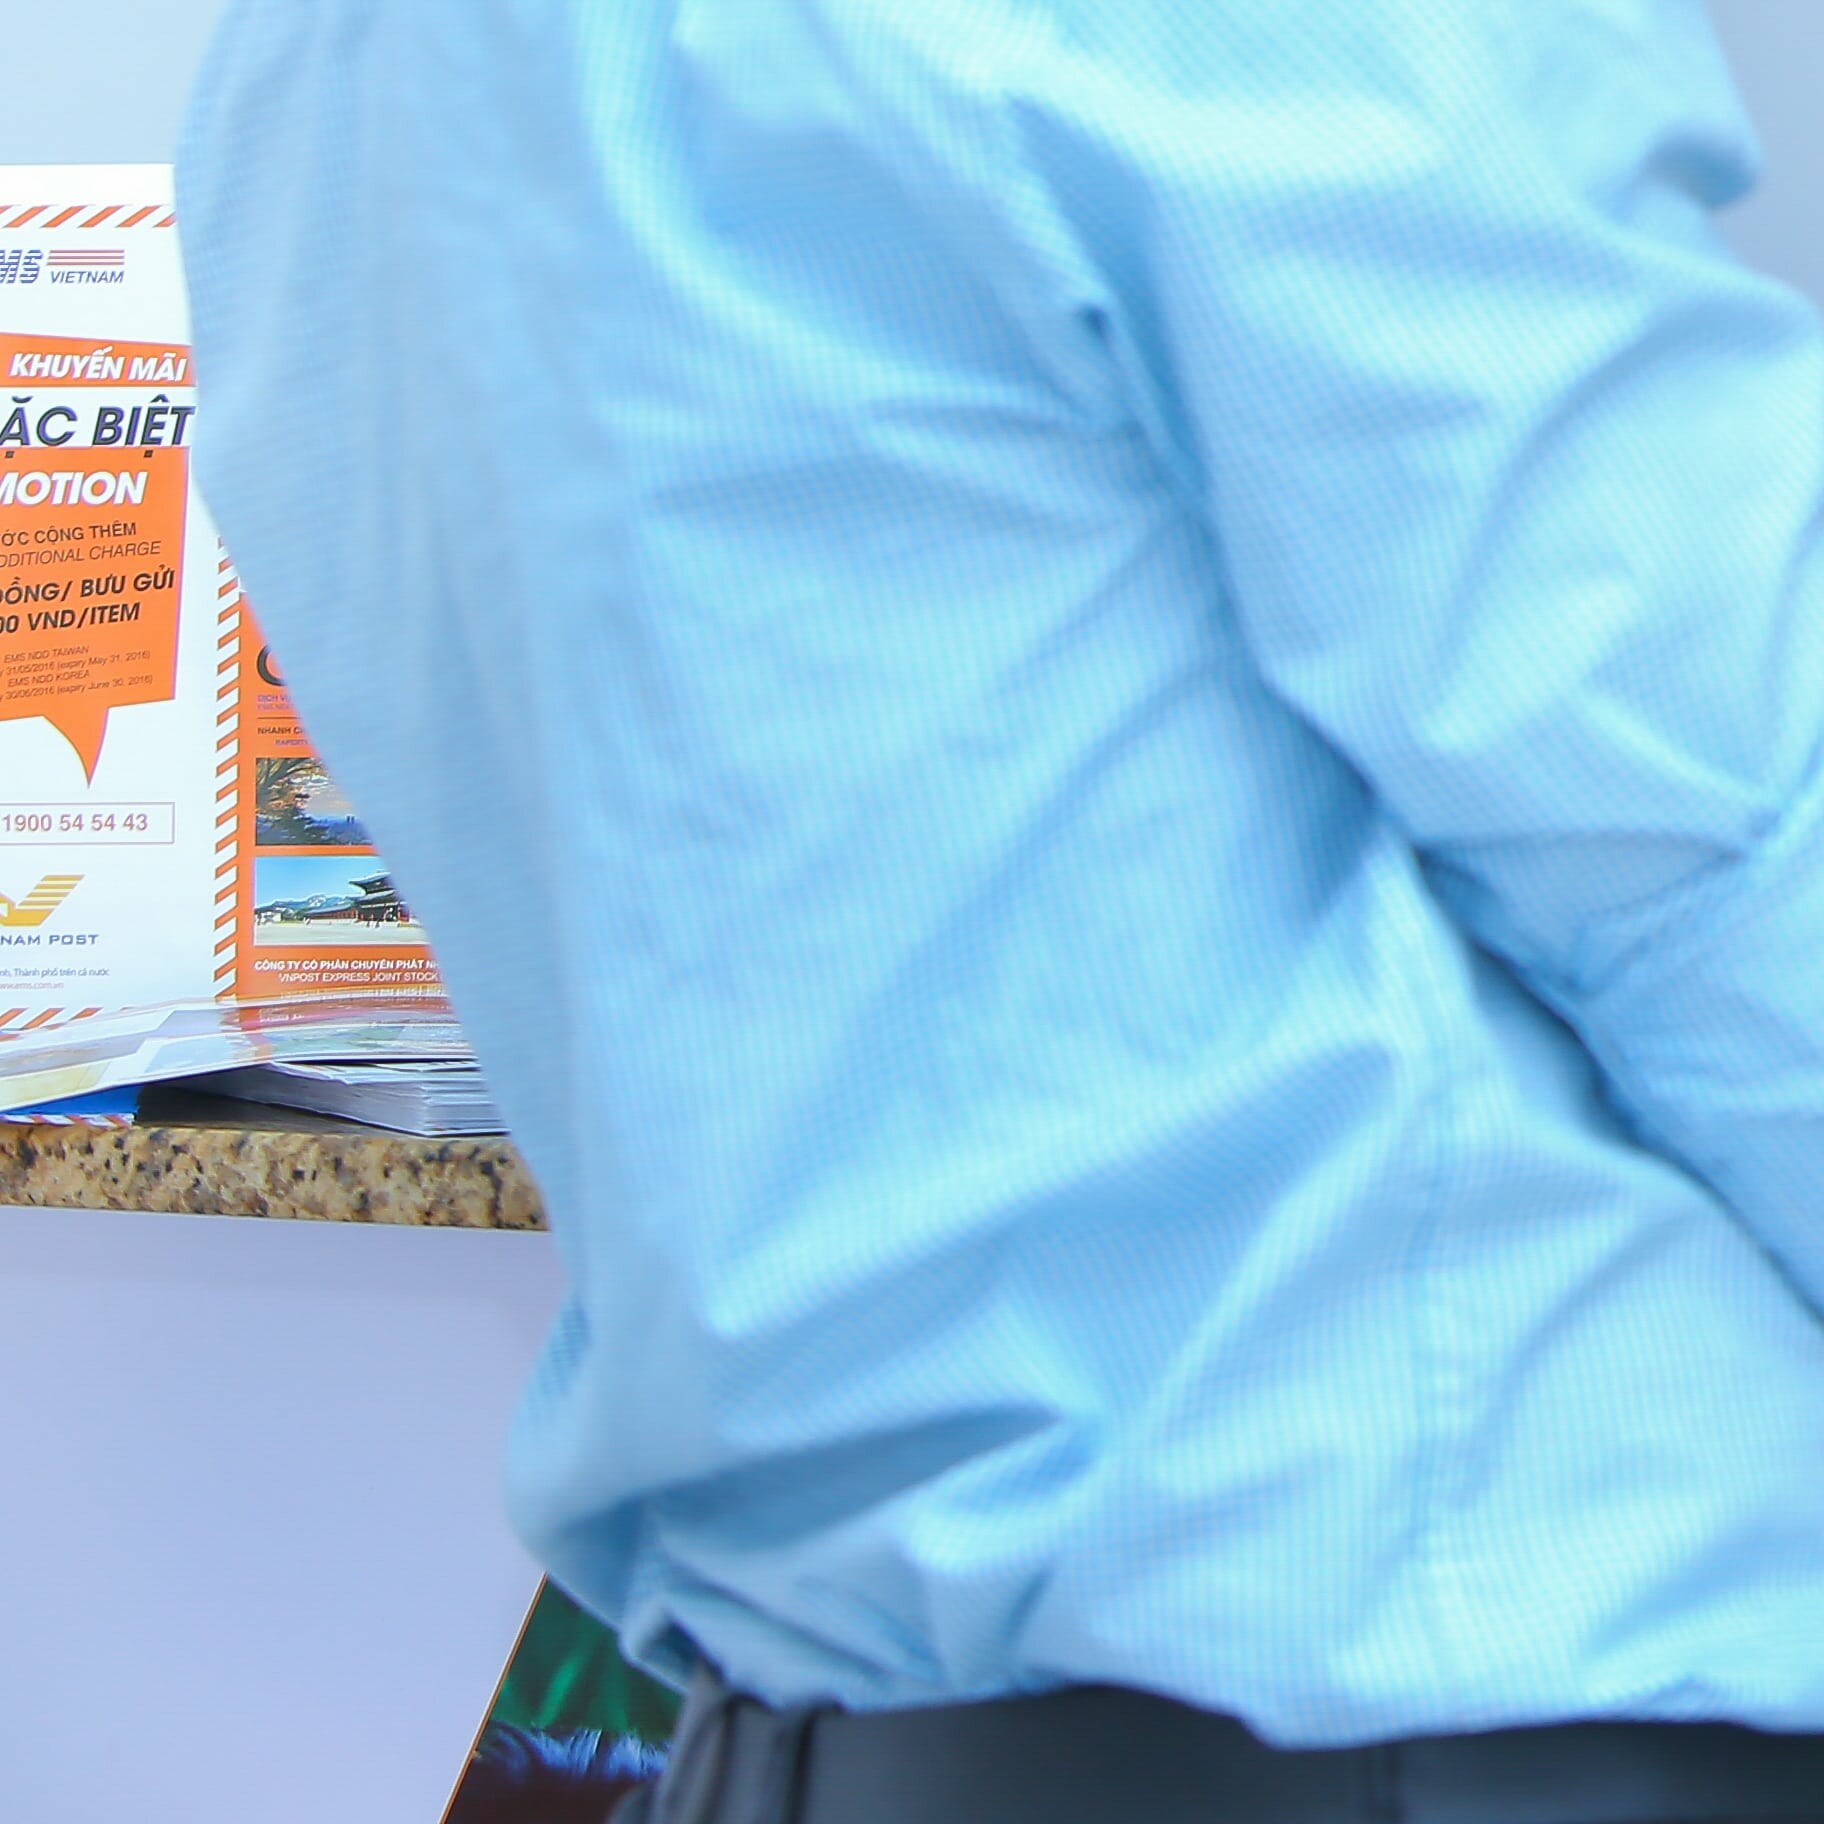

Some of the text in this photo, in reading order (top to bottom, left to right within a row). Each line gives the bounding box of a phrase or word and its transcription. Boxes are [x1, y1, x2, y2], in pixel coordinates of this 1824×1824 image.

[50, 270, 125, 284] VIETNAM
[10, 346, 188, 382] KHUYẾN MÃI
[92, 393, 196, 458] BIỆT
[0, 520, 137, 546] ỚC CỘNG THÊM
[89, 541, 161, 560] CHARGE
[0, 564, 175, 606] ỒNG/ BƯU GỬI
[28, 602, 140, 631] VND/ITEM
[2, 813, 148, 832] 1900 54 54 43
[49, 934, 99, 945] POST
[322, 973, 371, 982] EXPRESS
[372, 972, 401, 982] JOINT
